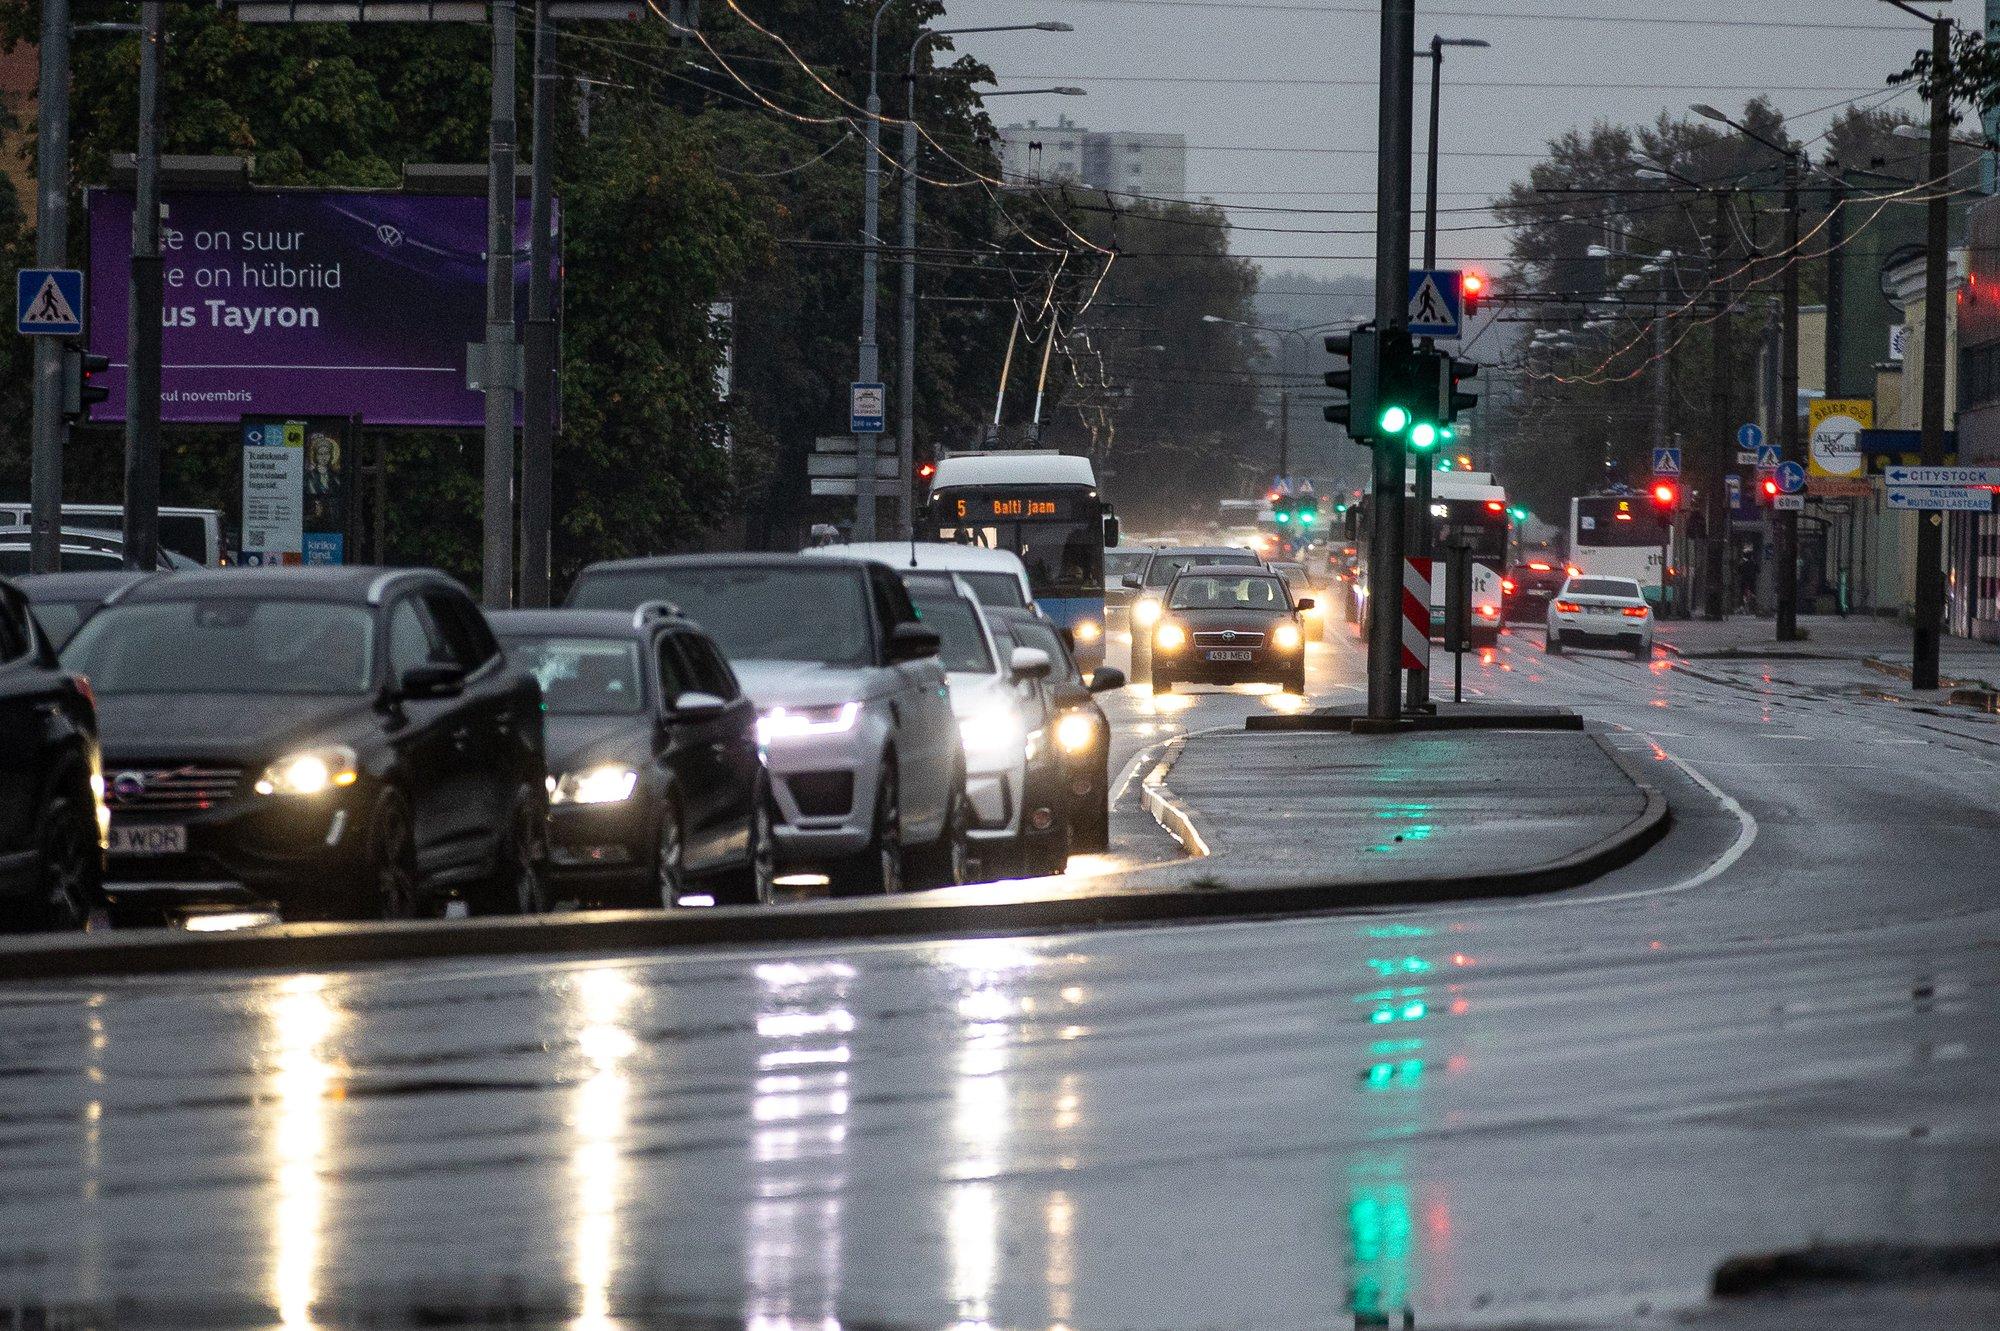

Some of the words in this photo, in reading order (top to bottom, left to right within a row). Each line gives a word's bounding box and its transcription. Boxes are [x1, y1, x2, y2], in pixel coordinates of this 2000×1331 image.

[195, 230, 230, 251] on
[242, 230, 304, 251] suur
[195, 268, 230, 288] on
[243, 262, 341, 288] hübriid
[205, 300, 319, 334] Tayron
[182, 390, 252, 402] novembris
[1910, 469, 1987, 482] CITYSTOCK
[1929, 489, 1968, 498] TALLINNA
[956, 500, 966, 517] 5
[993, 500, 1021, 515] Balti
[1027, 500, 1056, 516] jaam
[1230, 651, 1250, 660] MEG
